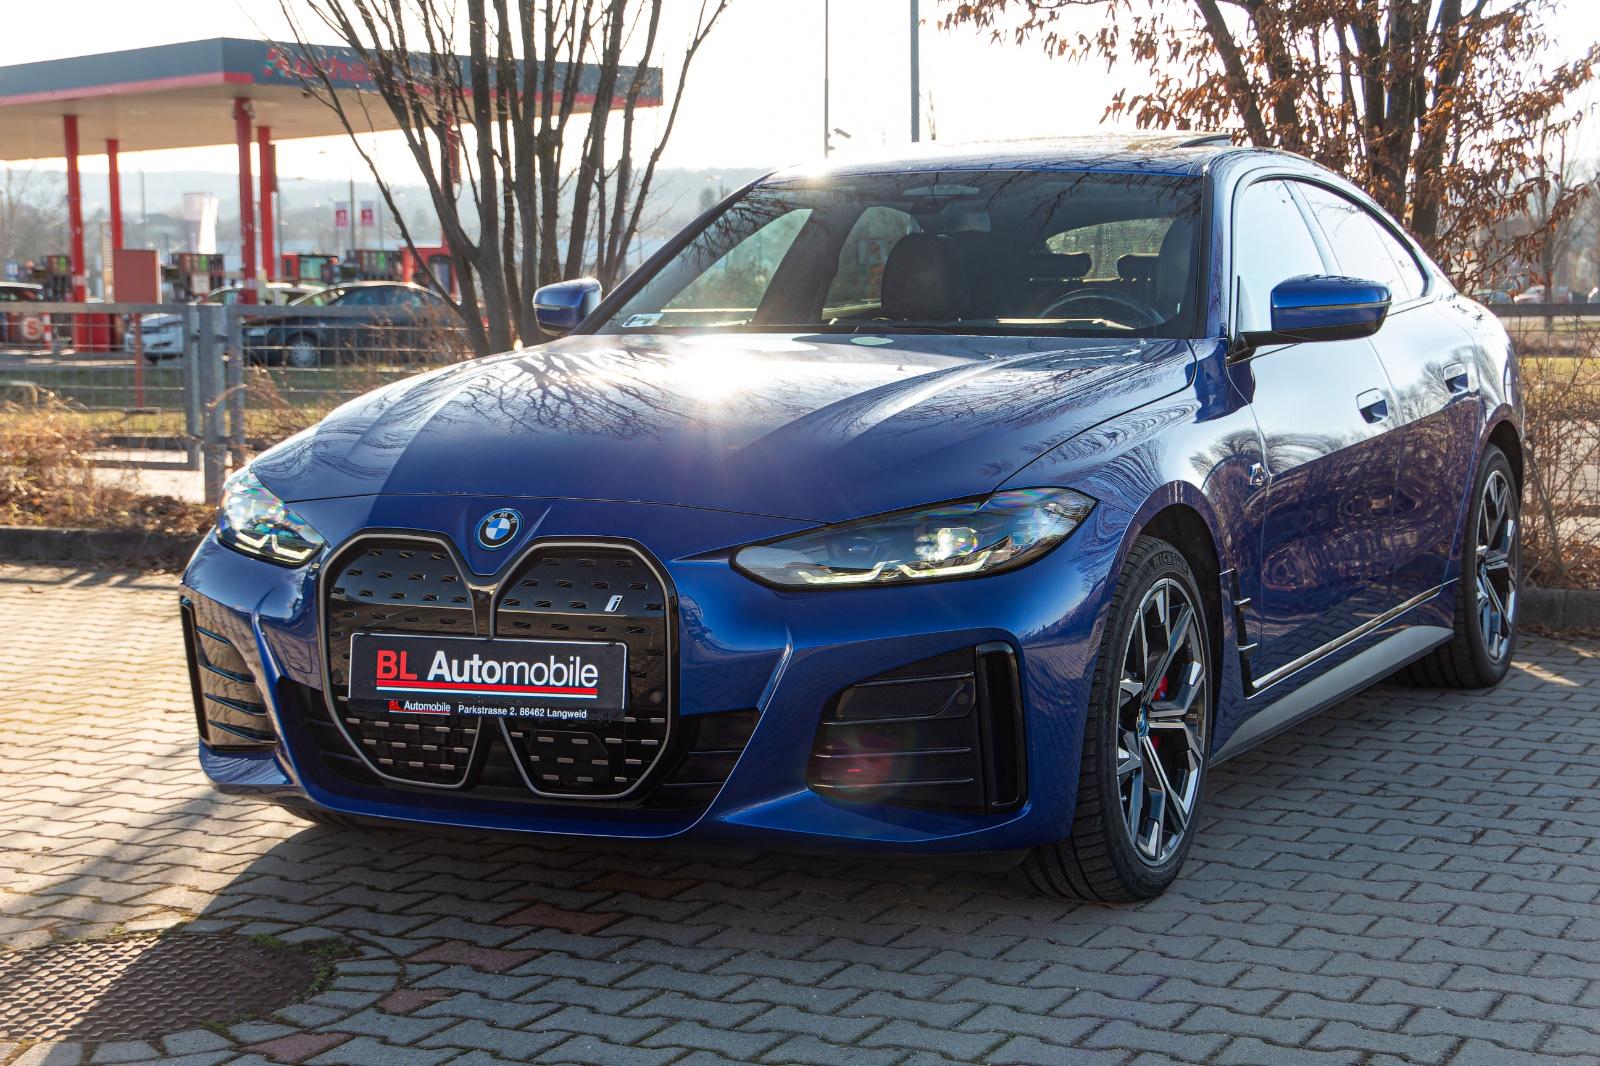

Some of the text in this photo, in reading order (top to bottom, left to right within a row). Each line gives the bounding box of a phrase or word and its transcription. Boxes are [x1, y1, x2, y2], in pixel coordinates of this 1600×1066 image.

[487, 512, 517, 524] BMW
[376, 649, 599, 688] BL Automobile
[389, 700, 402, 711] BL
[404, 700, 451, 712] Automobile
[458, 704, 508, 716] Parkstrasse
[519, 707, 545, 717] 86462
[547, 708, 587, 720] Langweid
